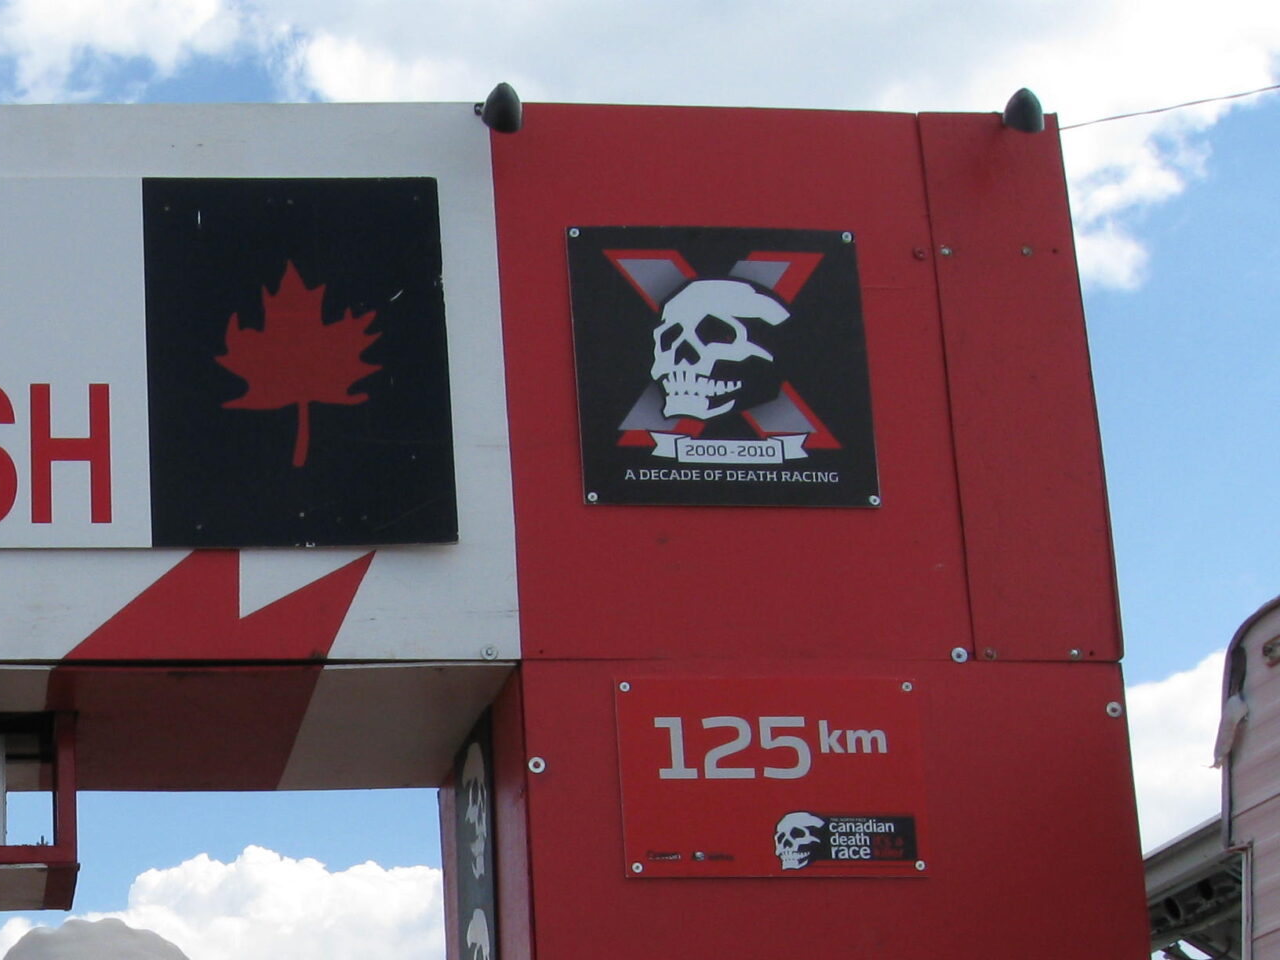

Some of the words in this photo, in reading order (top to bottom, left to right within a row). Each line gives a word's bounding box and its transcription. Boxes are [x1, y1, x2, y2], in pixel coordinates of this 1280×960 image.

[624, 469, 638, 481] A
[640, 469, 701, 482] DECADE
[704, 470, 723, 482] OF
[726, 470, 778, 483] DEATH
[781, 471, 839, 484] RACING
[829, 819, 895, 833] canadian
[830, 833, 871, 846] death
[831, 846, 872, 859] race
